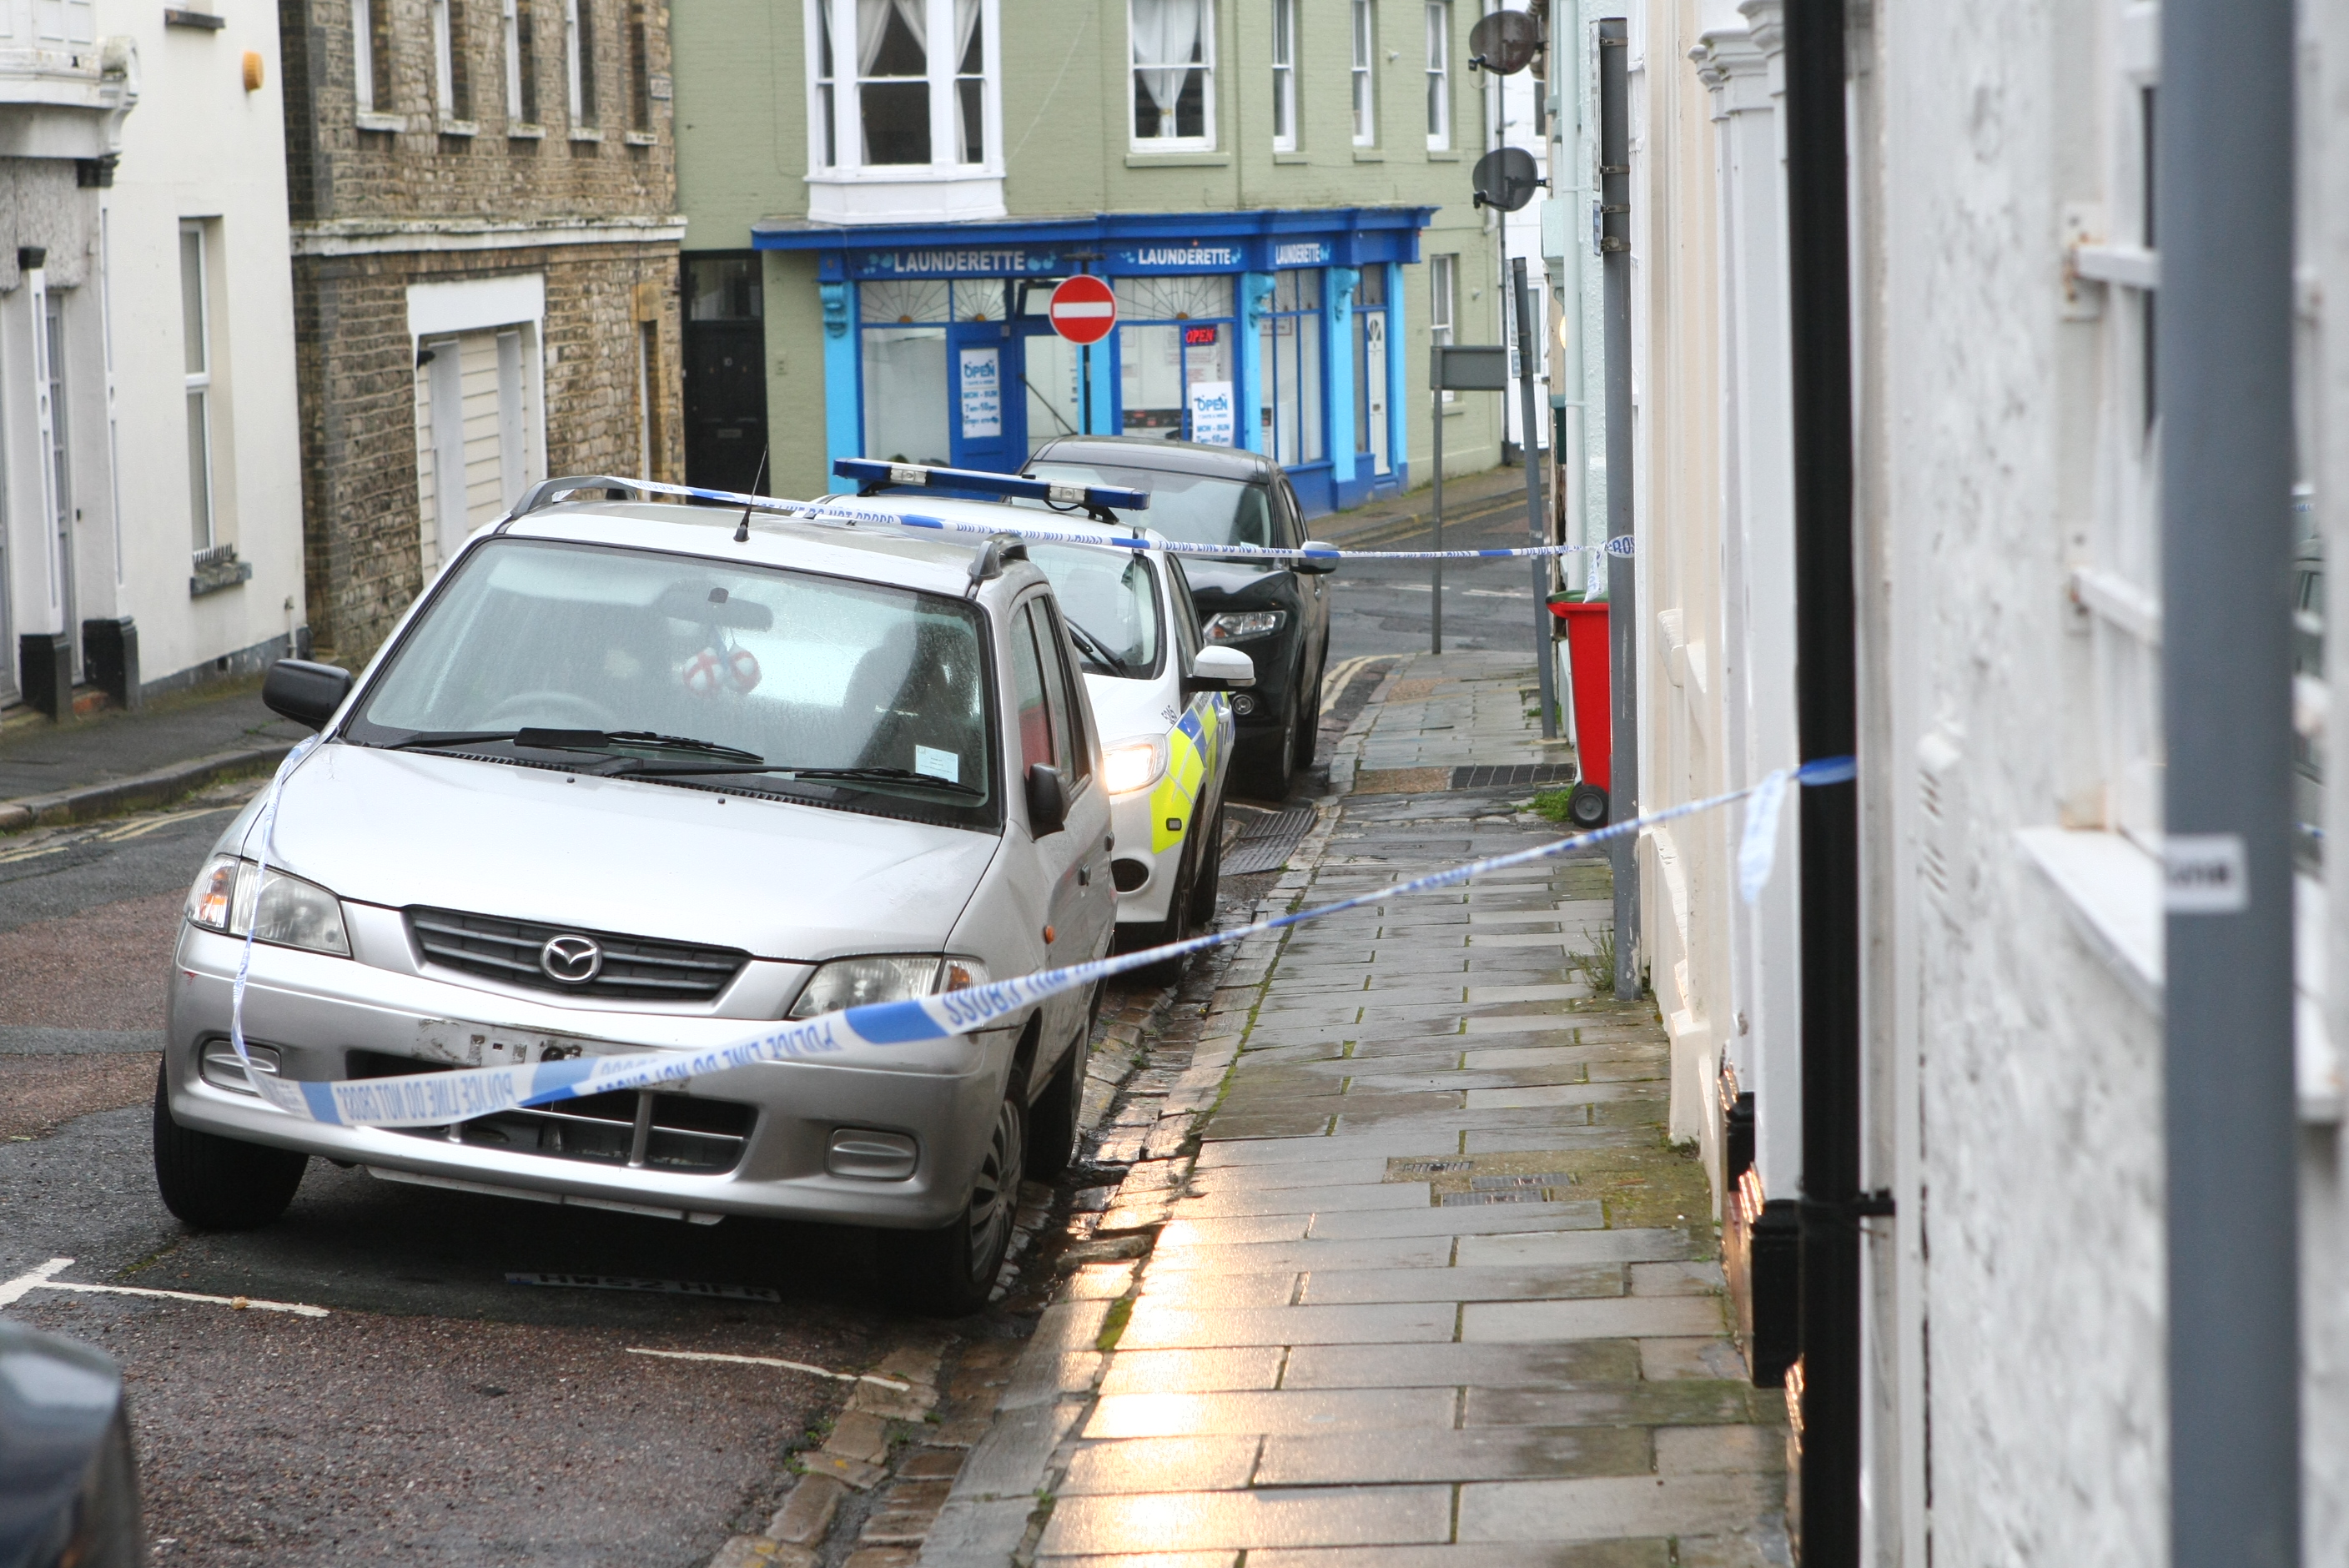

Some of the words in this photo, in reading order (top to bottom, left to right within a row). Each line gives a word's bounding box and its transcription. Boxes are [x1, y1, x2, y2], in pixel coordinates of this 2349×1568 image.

[894, 250, 1025, 273] LAUNDERETTE
[1138, 249, 1231, 265] LAUNDERETTE
[1275, 243, 1320, 265] LAUNDERETTE
[1185, 329, 1215, 343] OPEN
[964, 364, 995, 378] OPEN
[1197, 398, 1228, 411] OPEN
